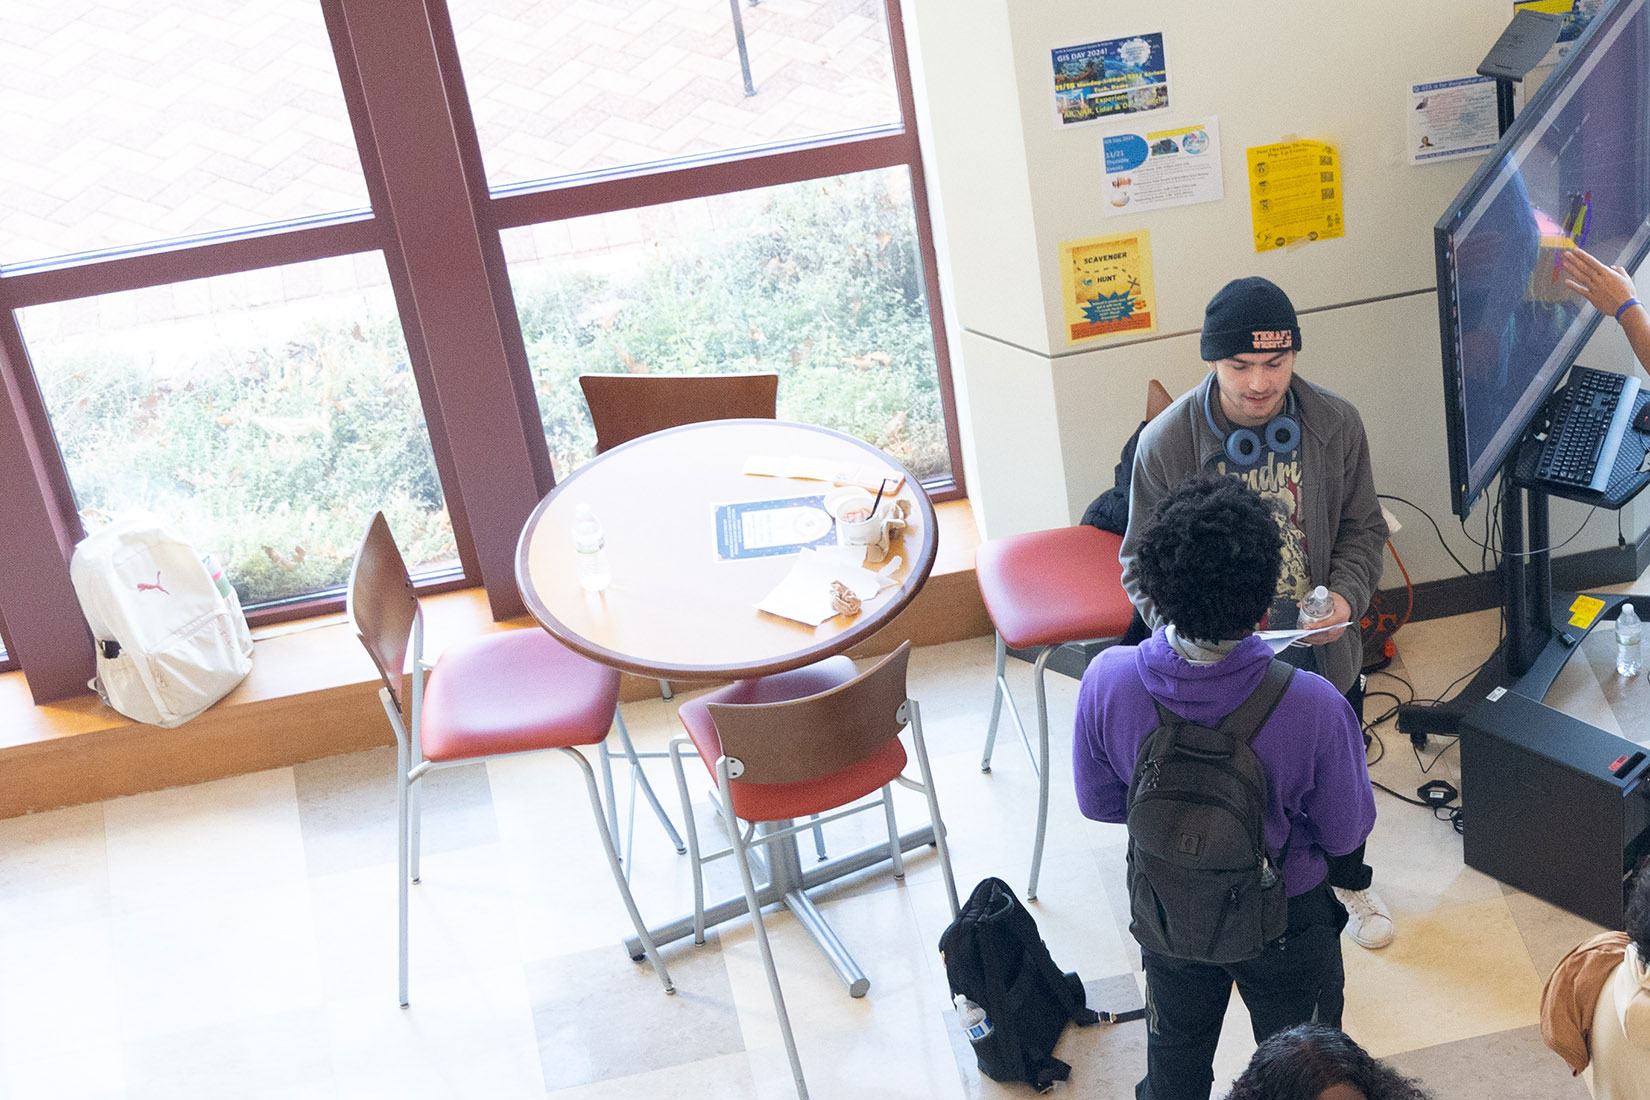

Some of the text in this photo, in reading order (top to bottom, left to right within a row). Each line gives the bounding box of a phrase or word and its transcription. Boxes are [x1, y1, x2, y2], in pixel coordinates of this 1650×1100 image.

[1057, 48, 1108, 62] GIS DAY 2024!
[1106, 150, 1124, 158] 11/21
[1106, 158, 1129, 166] Thursday
[1084, 252, 1128, 264] SCAVENGER
[1097, 274, 1117, 284] HUNT
